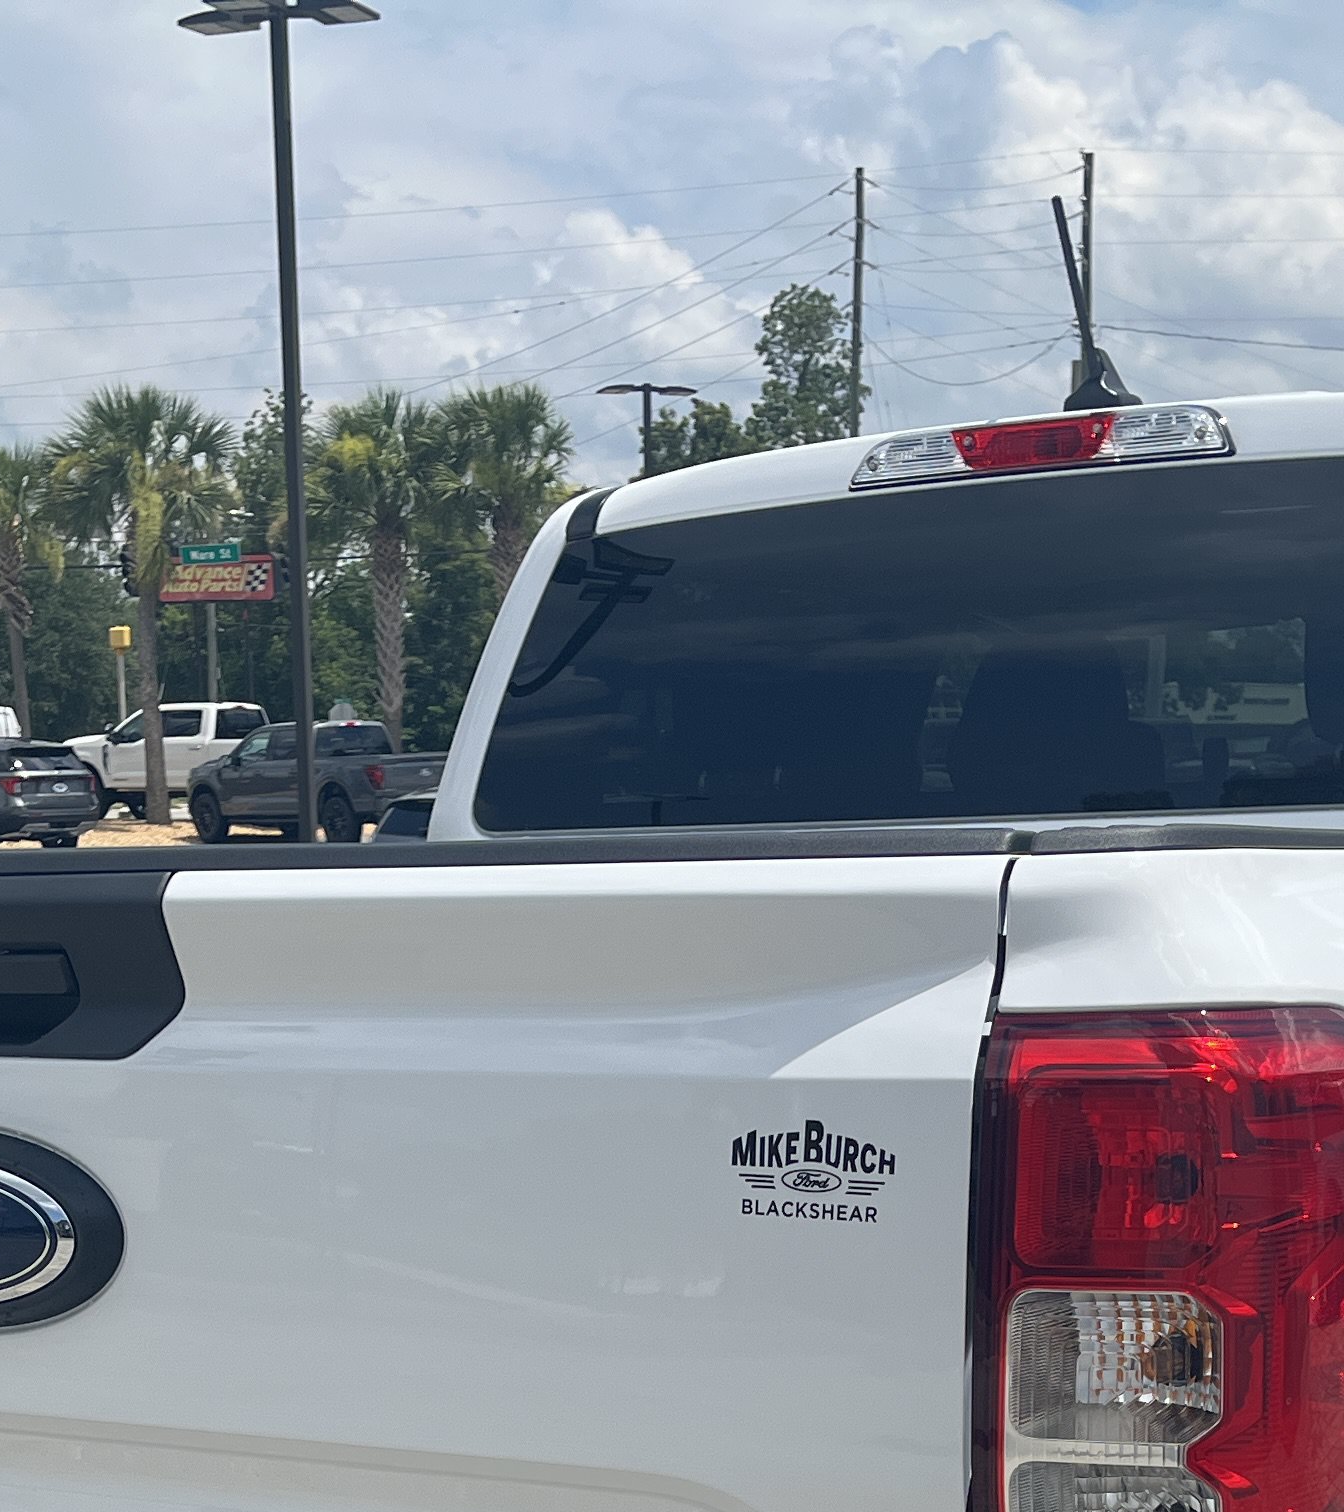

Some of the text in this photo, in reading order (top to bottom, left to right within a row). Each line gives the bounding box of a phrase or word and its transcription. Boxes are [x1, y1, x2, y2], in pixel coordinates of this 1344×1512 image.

[199, 579, 244, 593] Parts
[792, 1172, 831, 1189] Ford
[741, 1198, 878, 1223] BLACKSHEAR
